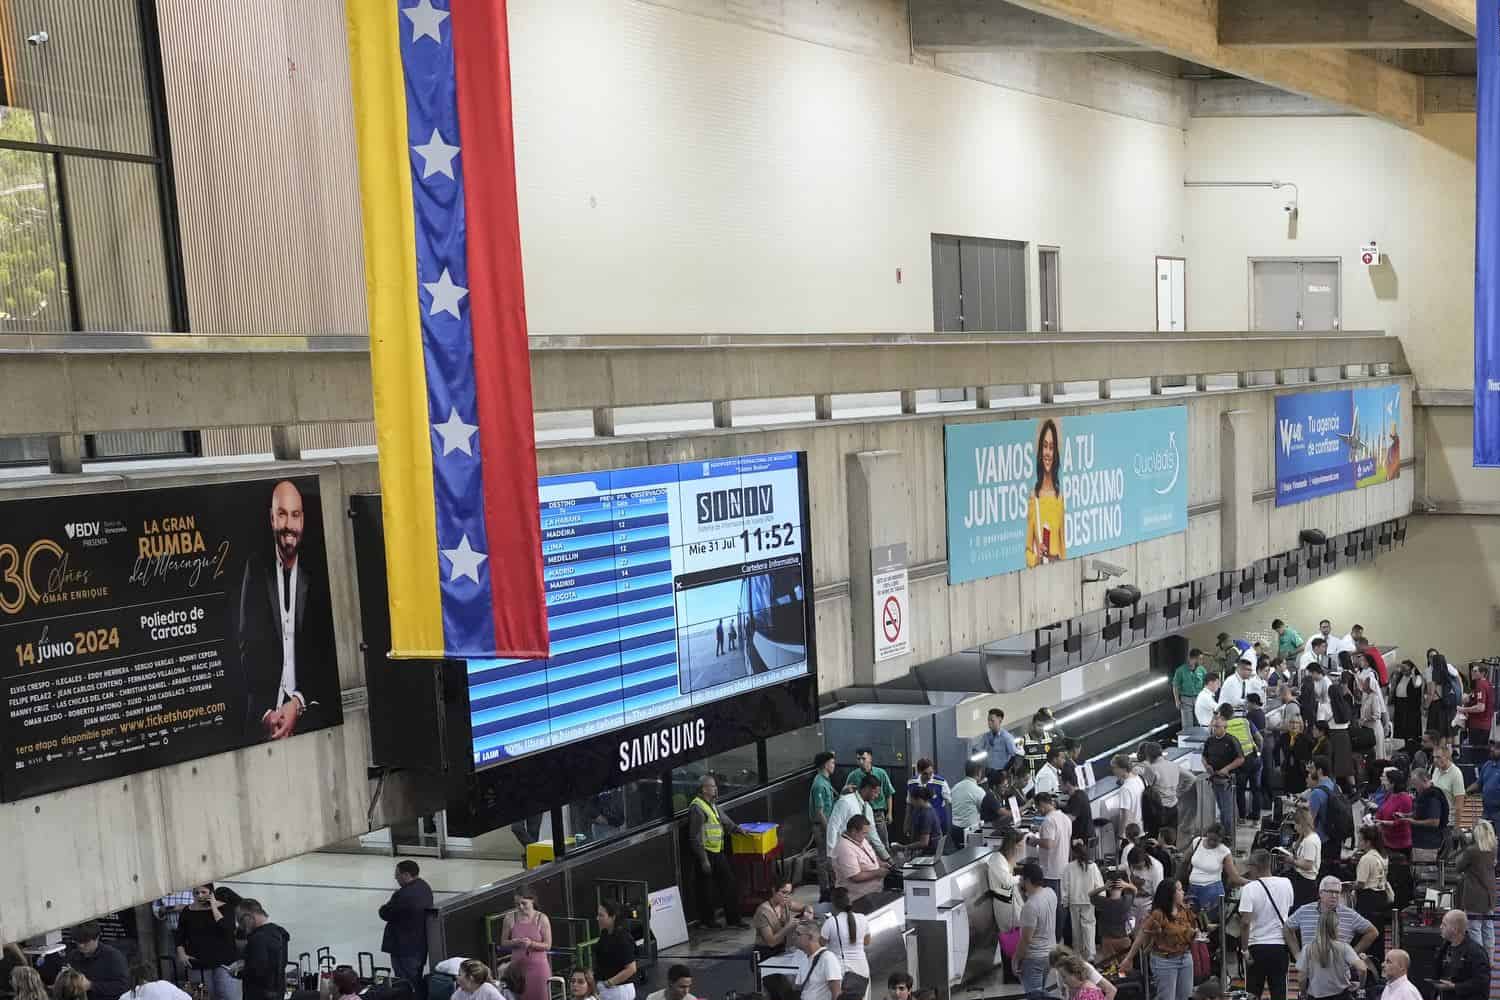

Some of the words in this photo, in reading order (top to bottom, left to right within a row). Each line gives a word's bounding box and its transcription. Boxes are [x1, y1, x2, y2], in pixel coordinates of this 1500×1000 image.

[1316, 413, 1340, 436] agencia
[1063, 436, 1073, 472] A
[1076, 433, 1095, 469] TU
[1308, 441, 1315, 456] de
[1315, 438, 1340, 455] confianza
[975, 441, 1033, 484] VAMOS
[698, 485, 773, 523] SINIV
[964, 483, 1028, 528] JUNTOS
[75, 520, 100, 538] BDV
[143, 519, 160, 535] LA
[162, 515, 195, 532] GRAN
[740, 522, 795, 553] 11:52
[1065, 505, 1122, 547] DESTINO
[138, 531, 207, 559] RUMBA
[689, 543, 706, 557] Mie
[709, 541, 719, 553] 31
[722, 538, 735, 550] Jul
[43, 591, 67, 604] OMAR
[71, 587, 109, 601] ENRIQUE
[140, 608, 187, 629] Poliedro
[191, 606, 204, 620] de
[151, 623, 198, 641] Caracas
[16, 643, 34, 667] 14
[37, 642, 74, 663] JUNIO
[74, 627, 120, 655] 2024
[120, 703, 226, 734] www.ticketshopve.com
[619, 717, 705, 772] SAMSUNG
